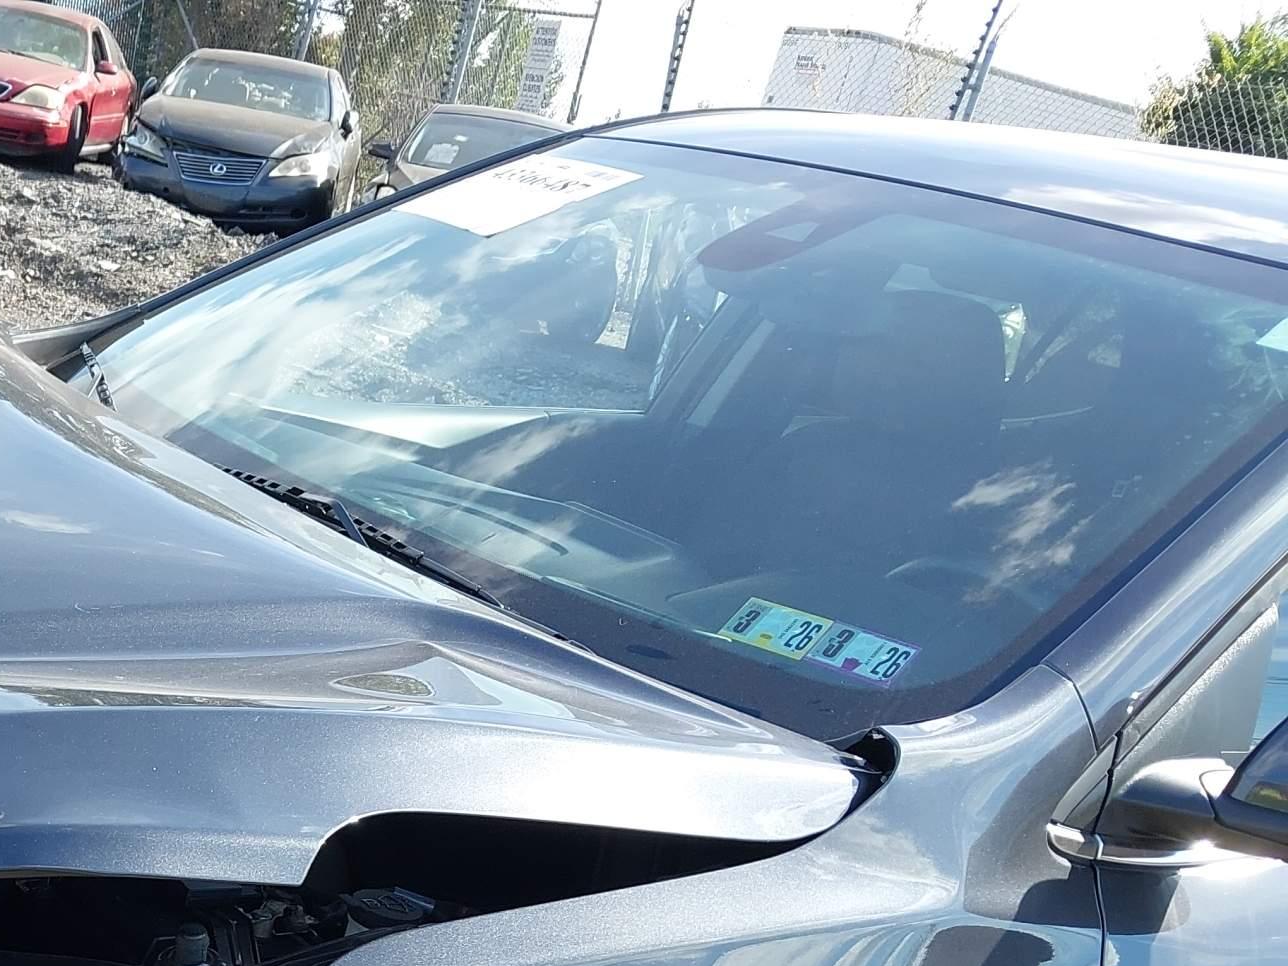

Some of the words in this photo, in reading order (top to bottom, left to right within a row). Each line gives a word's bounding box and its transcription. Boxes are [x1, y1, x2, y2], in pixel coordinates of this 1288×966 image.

[732, 609, 762, 634] 3
[784, 620, 824, 651] 26
[823, 629, 856, 658] 3
[870, 646, 911, 678] 26
